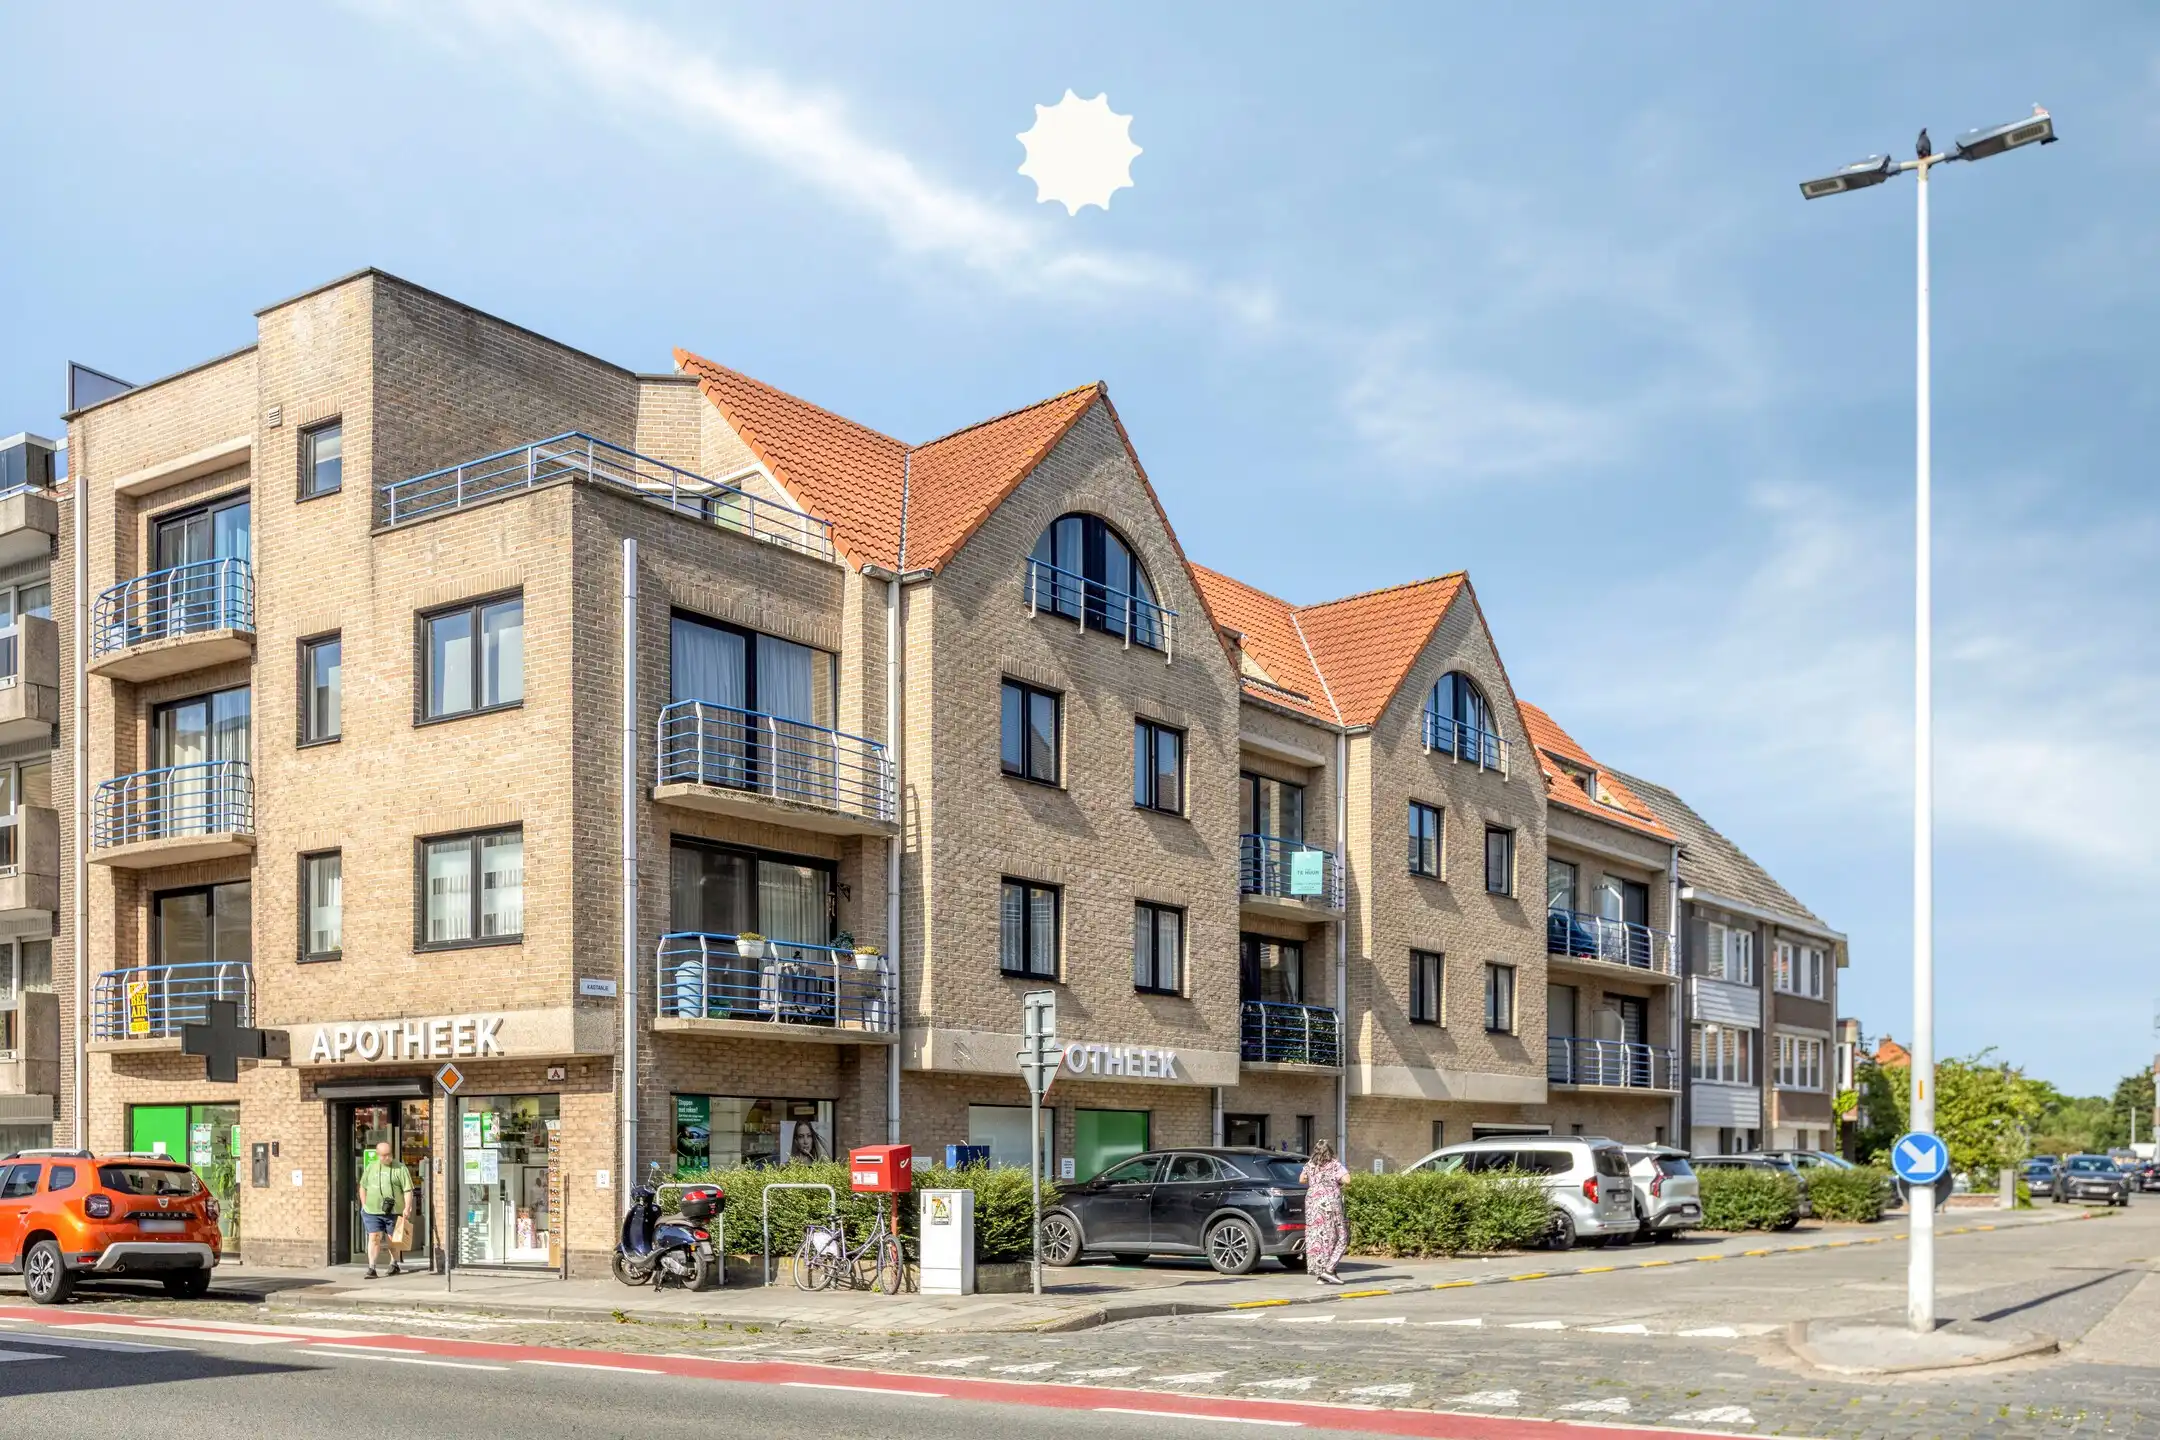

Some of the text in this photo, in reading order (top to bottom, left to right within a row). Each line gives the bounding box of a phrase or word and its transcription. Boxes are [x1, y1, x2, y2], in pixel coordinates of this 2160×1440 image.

[131, 993, 147, 1006] BEL
[131, 1005, 148, 1018] AIR
[310, 1017, 505, 1062] APOTHEEK
[1054, 1041, 1178, 1079] OTHEEK
